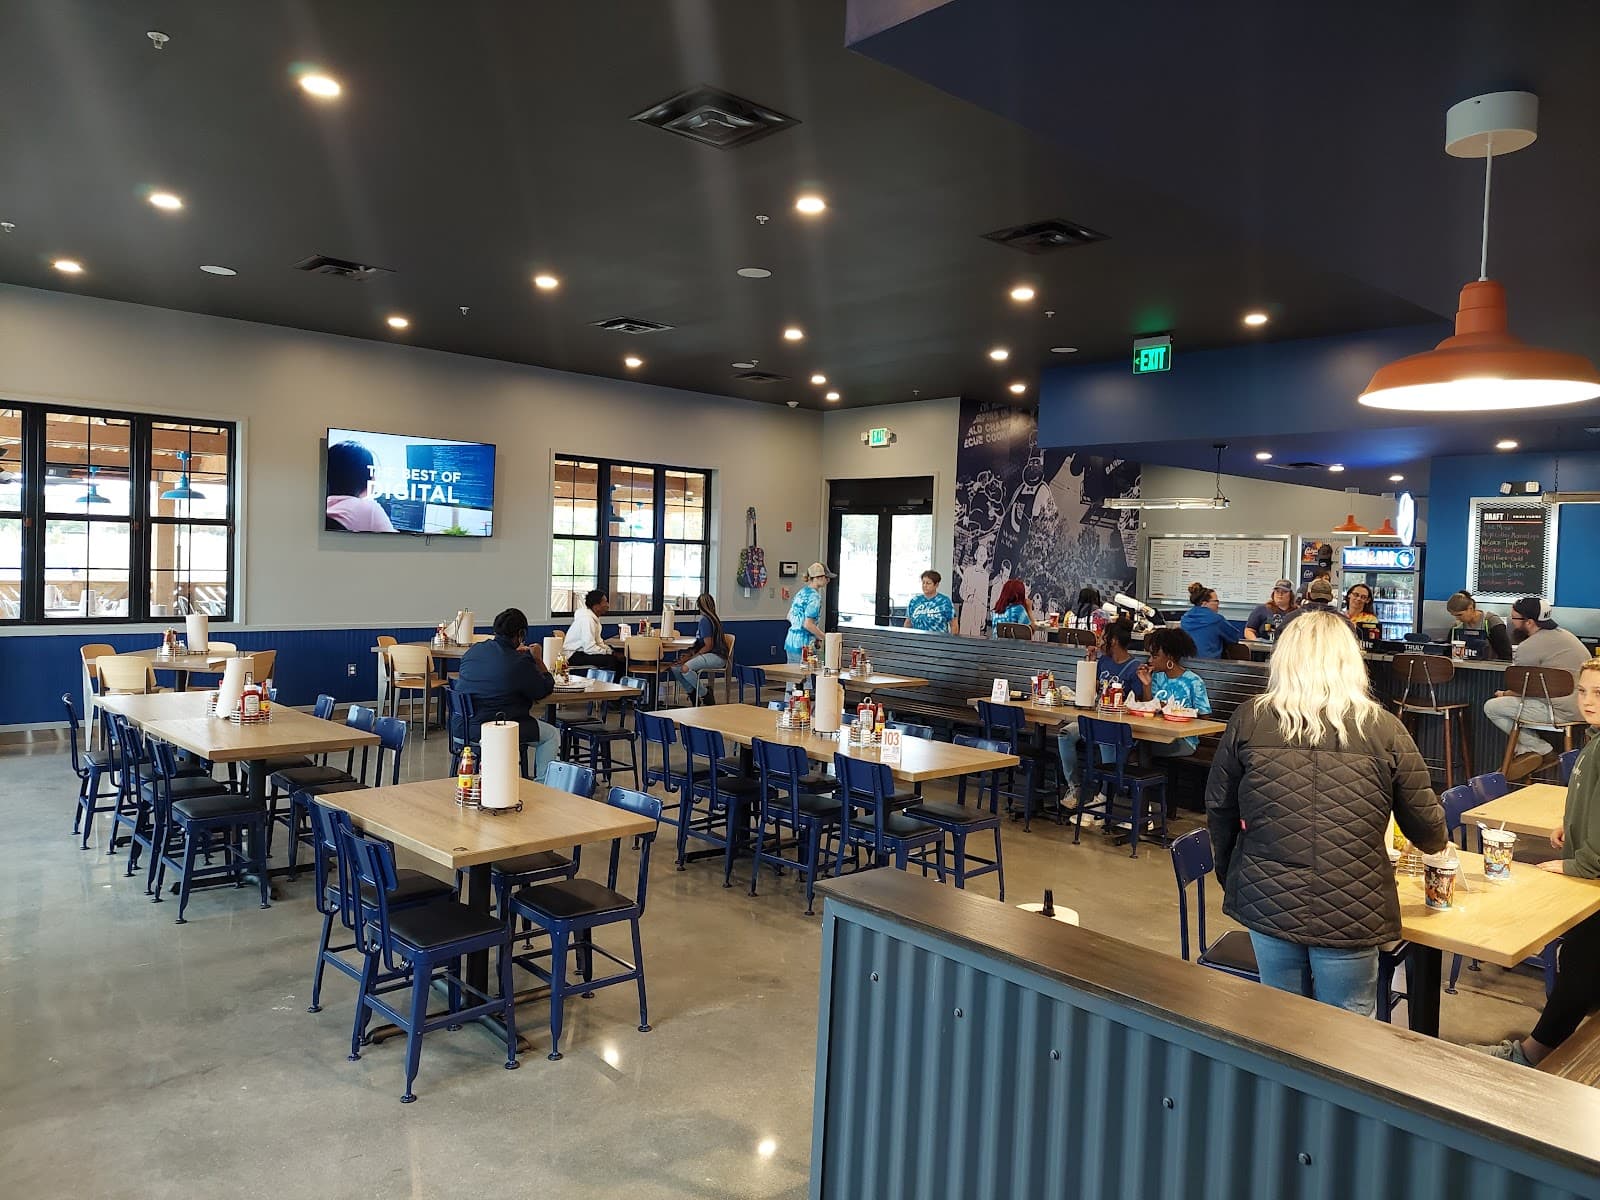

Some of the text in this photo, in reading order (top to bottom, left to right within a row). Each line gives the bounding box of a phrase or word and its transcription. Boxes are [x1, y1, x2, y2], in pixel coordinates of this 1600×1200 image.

[1140, 347, 1166, 371] EXIT
[872, 429, 885, 443] EXIT
[403, 468, 438, 481] BEST
[441, 471, 462, 484] OF
[366, 480, 460, 504] DIGITAL
[884, 731, 900, 746] 103
